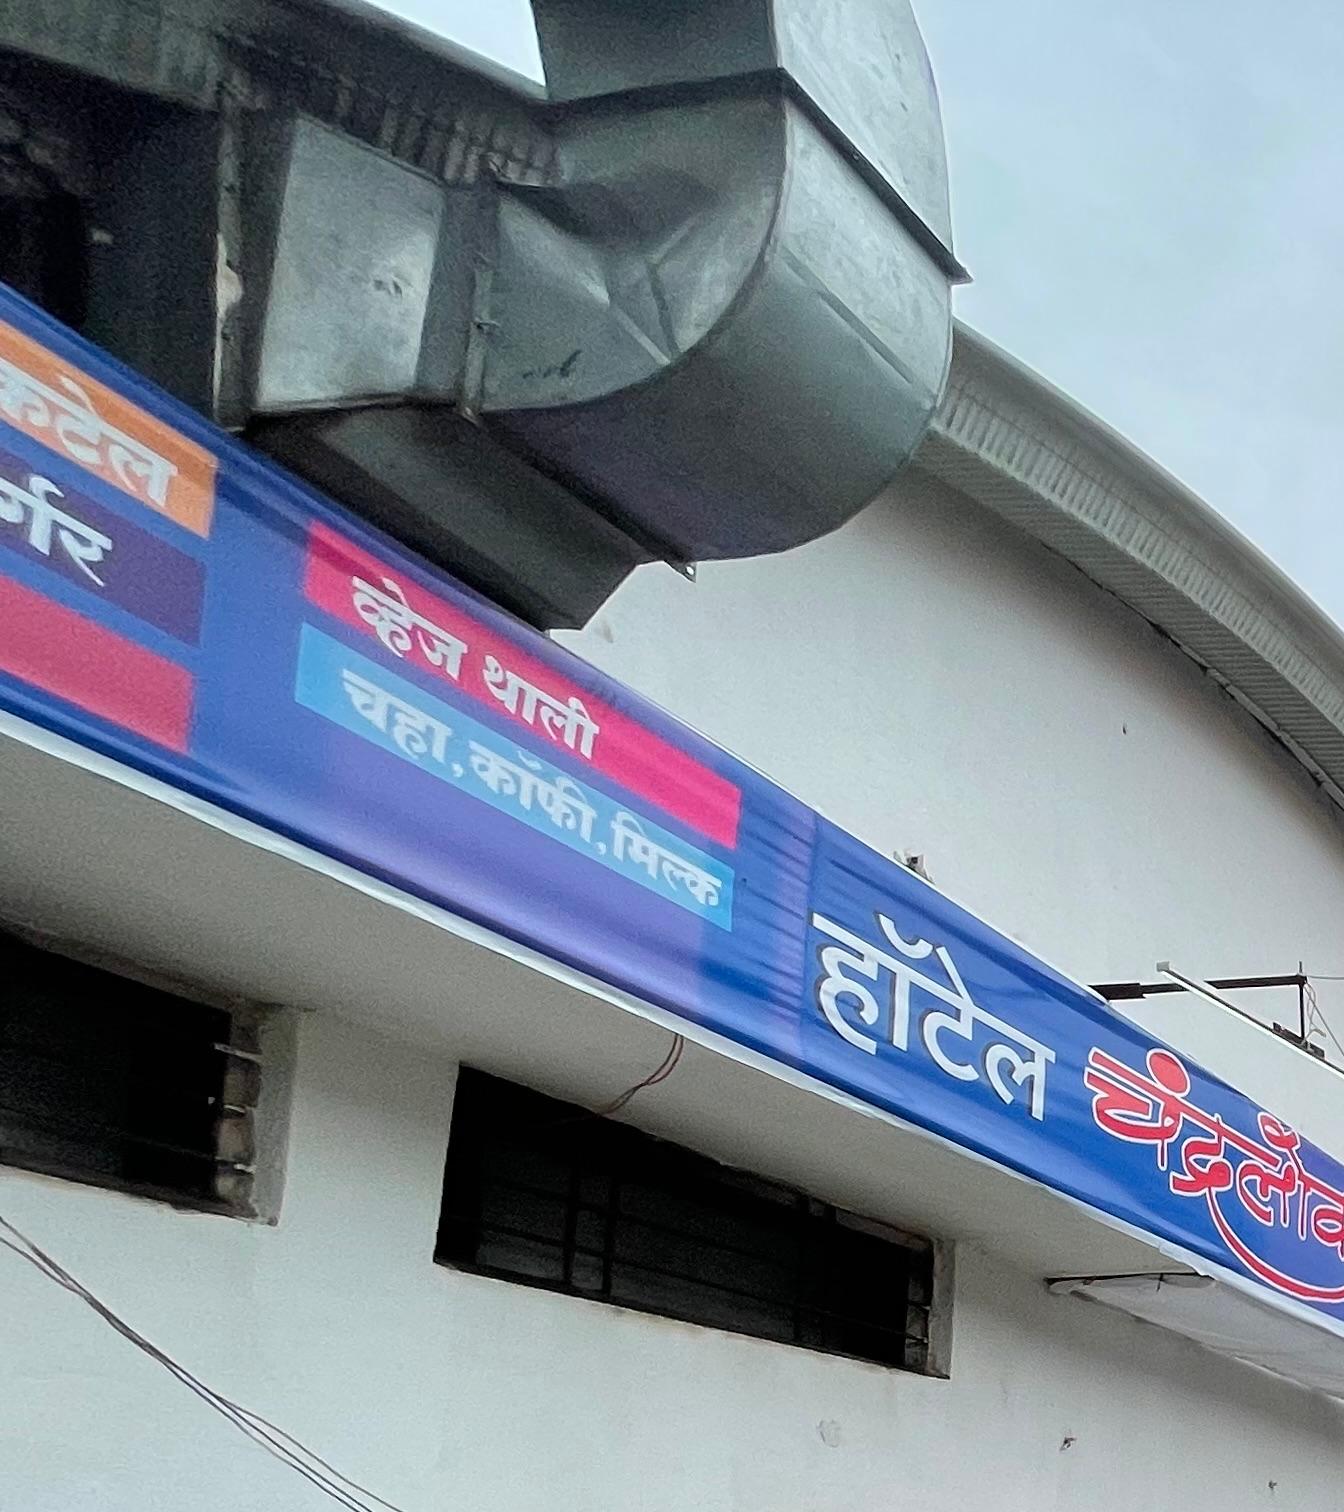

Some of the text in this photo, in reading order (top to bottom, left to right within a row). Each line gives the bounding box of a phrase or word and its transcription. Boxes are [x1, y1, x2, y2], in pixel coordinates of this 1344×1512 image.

[352, 576, 599, 760] व्हेज थाली
[611, 811, 722, 907] मिल्क
[812, 912, 1056, 1121] हॉटेल
